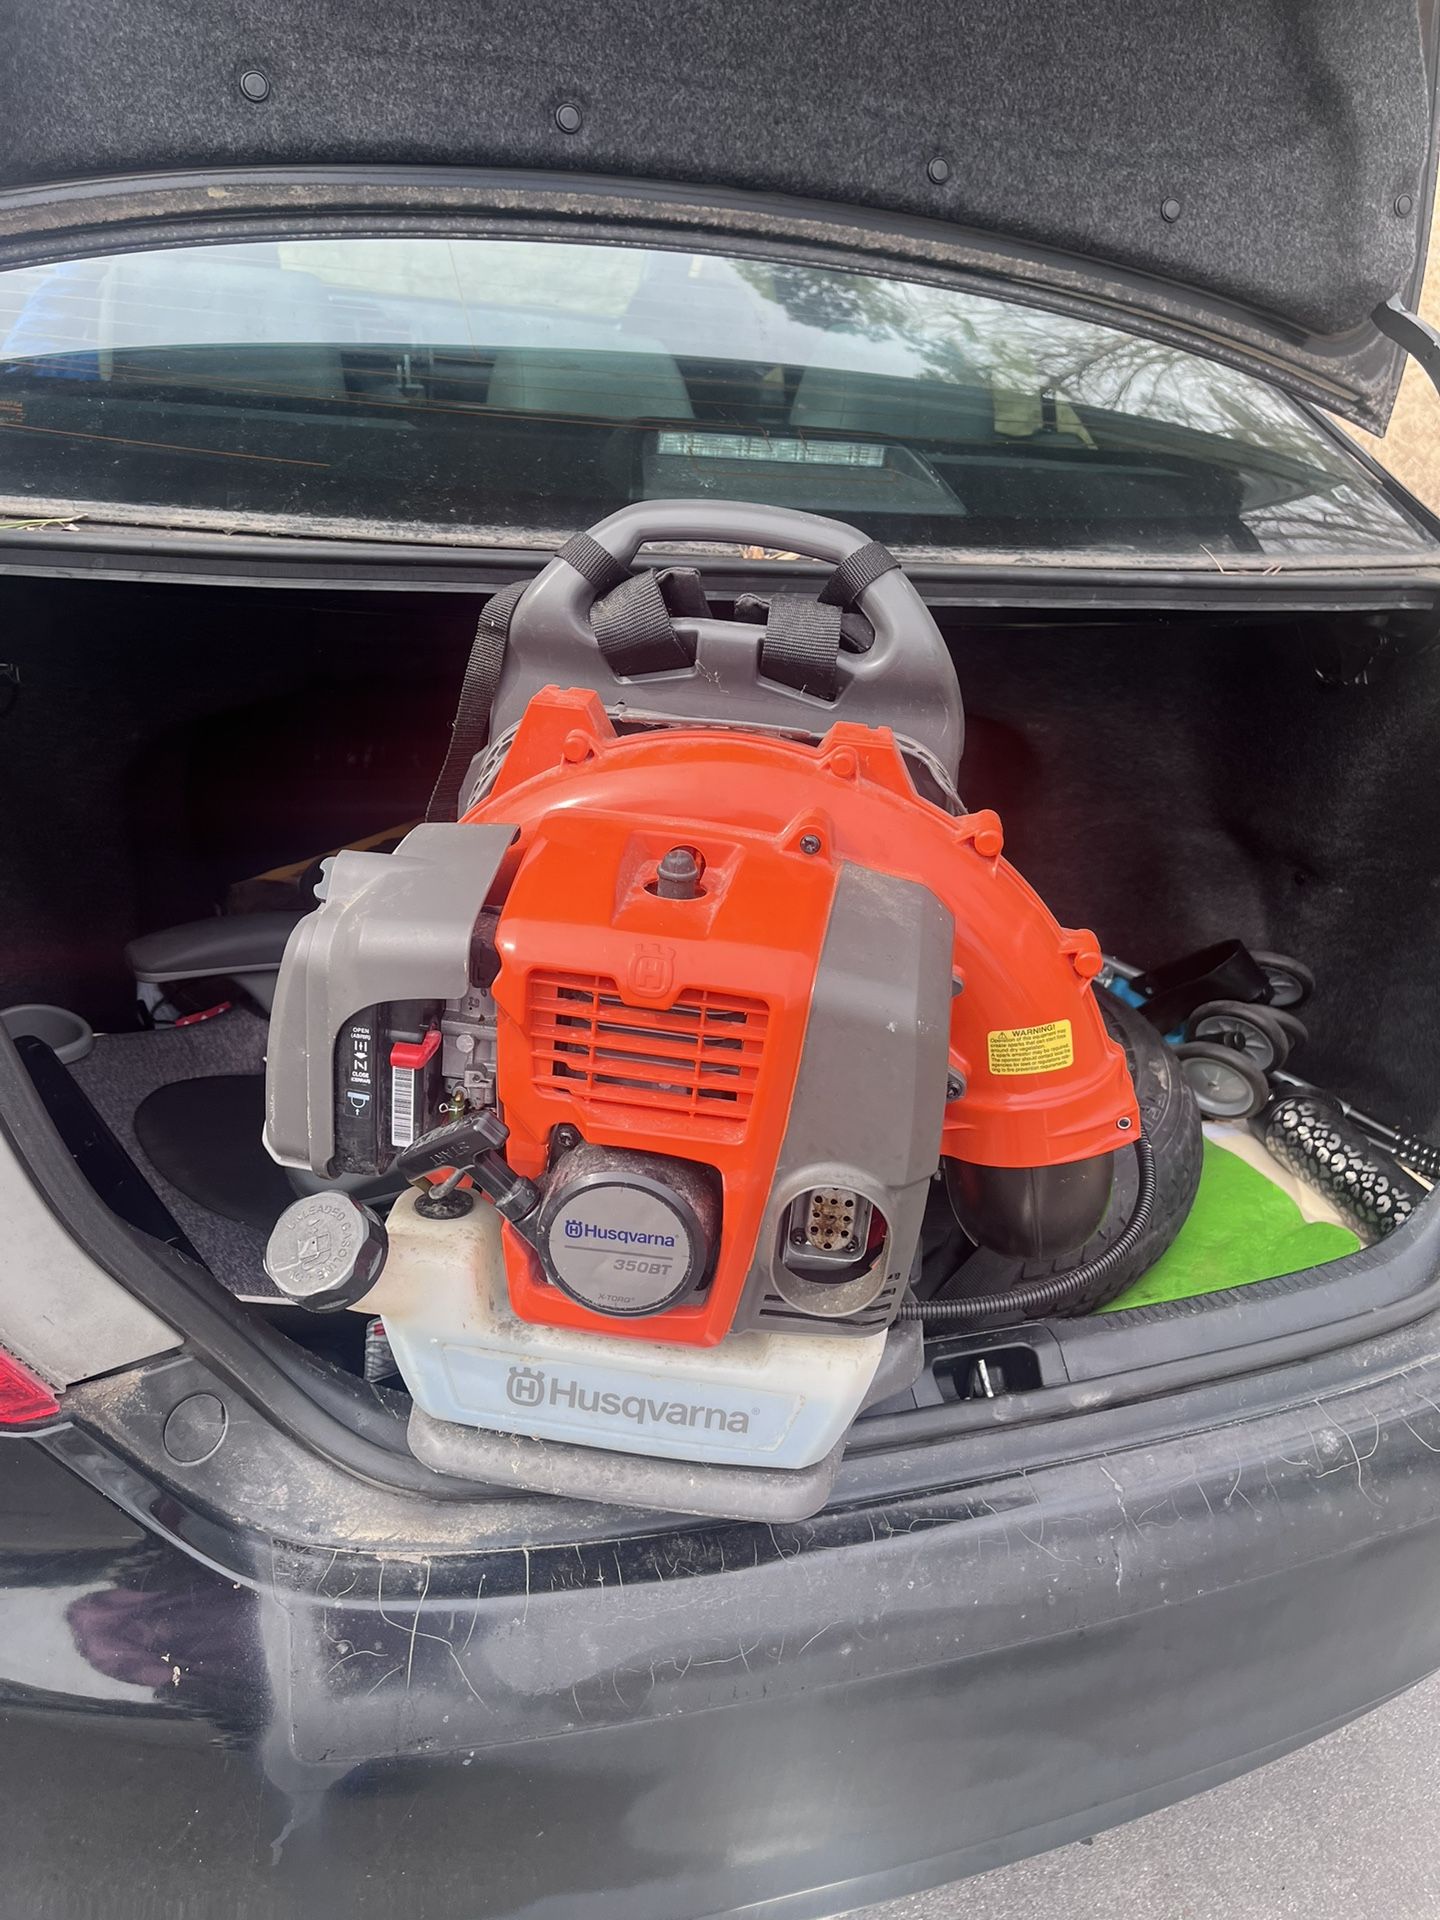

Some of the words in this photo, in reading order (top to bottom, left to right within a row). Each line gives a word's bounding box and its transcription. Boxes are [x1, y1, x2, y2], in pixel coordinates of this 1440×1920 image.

[1012, 1024, 1055, 1037] WARNING!
[287, 1205, 346, 1231] UNLEADED
[584, 1223, 675, 1247] Husqvarna
[316, 1221, 353, 1281] GASOLINE
[613, 1259, 672, 1275] 350BT
[549, 1377, 749, 1434] Husqvarna
